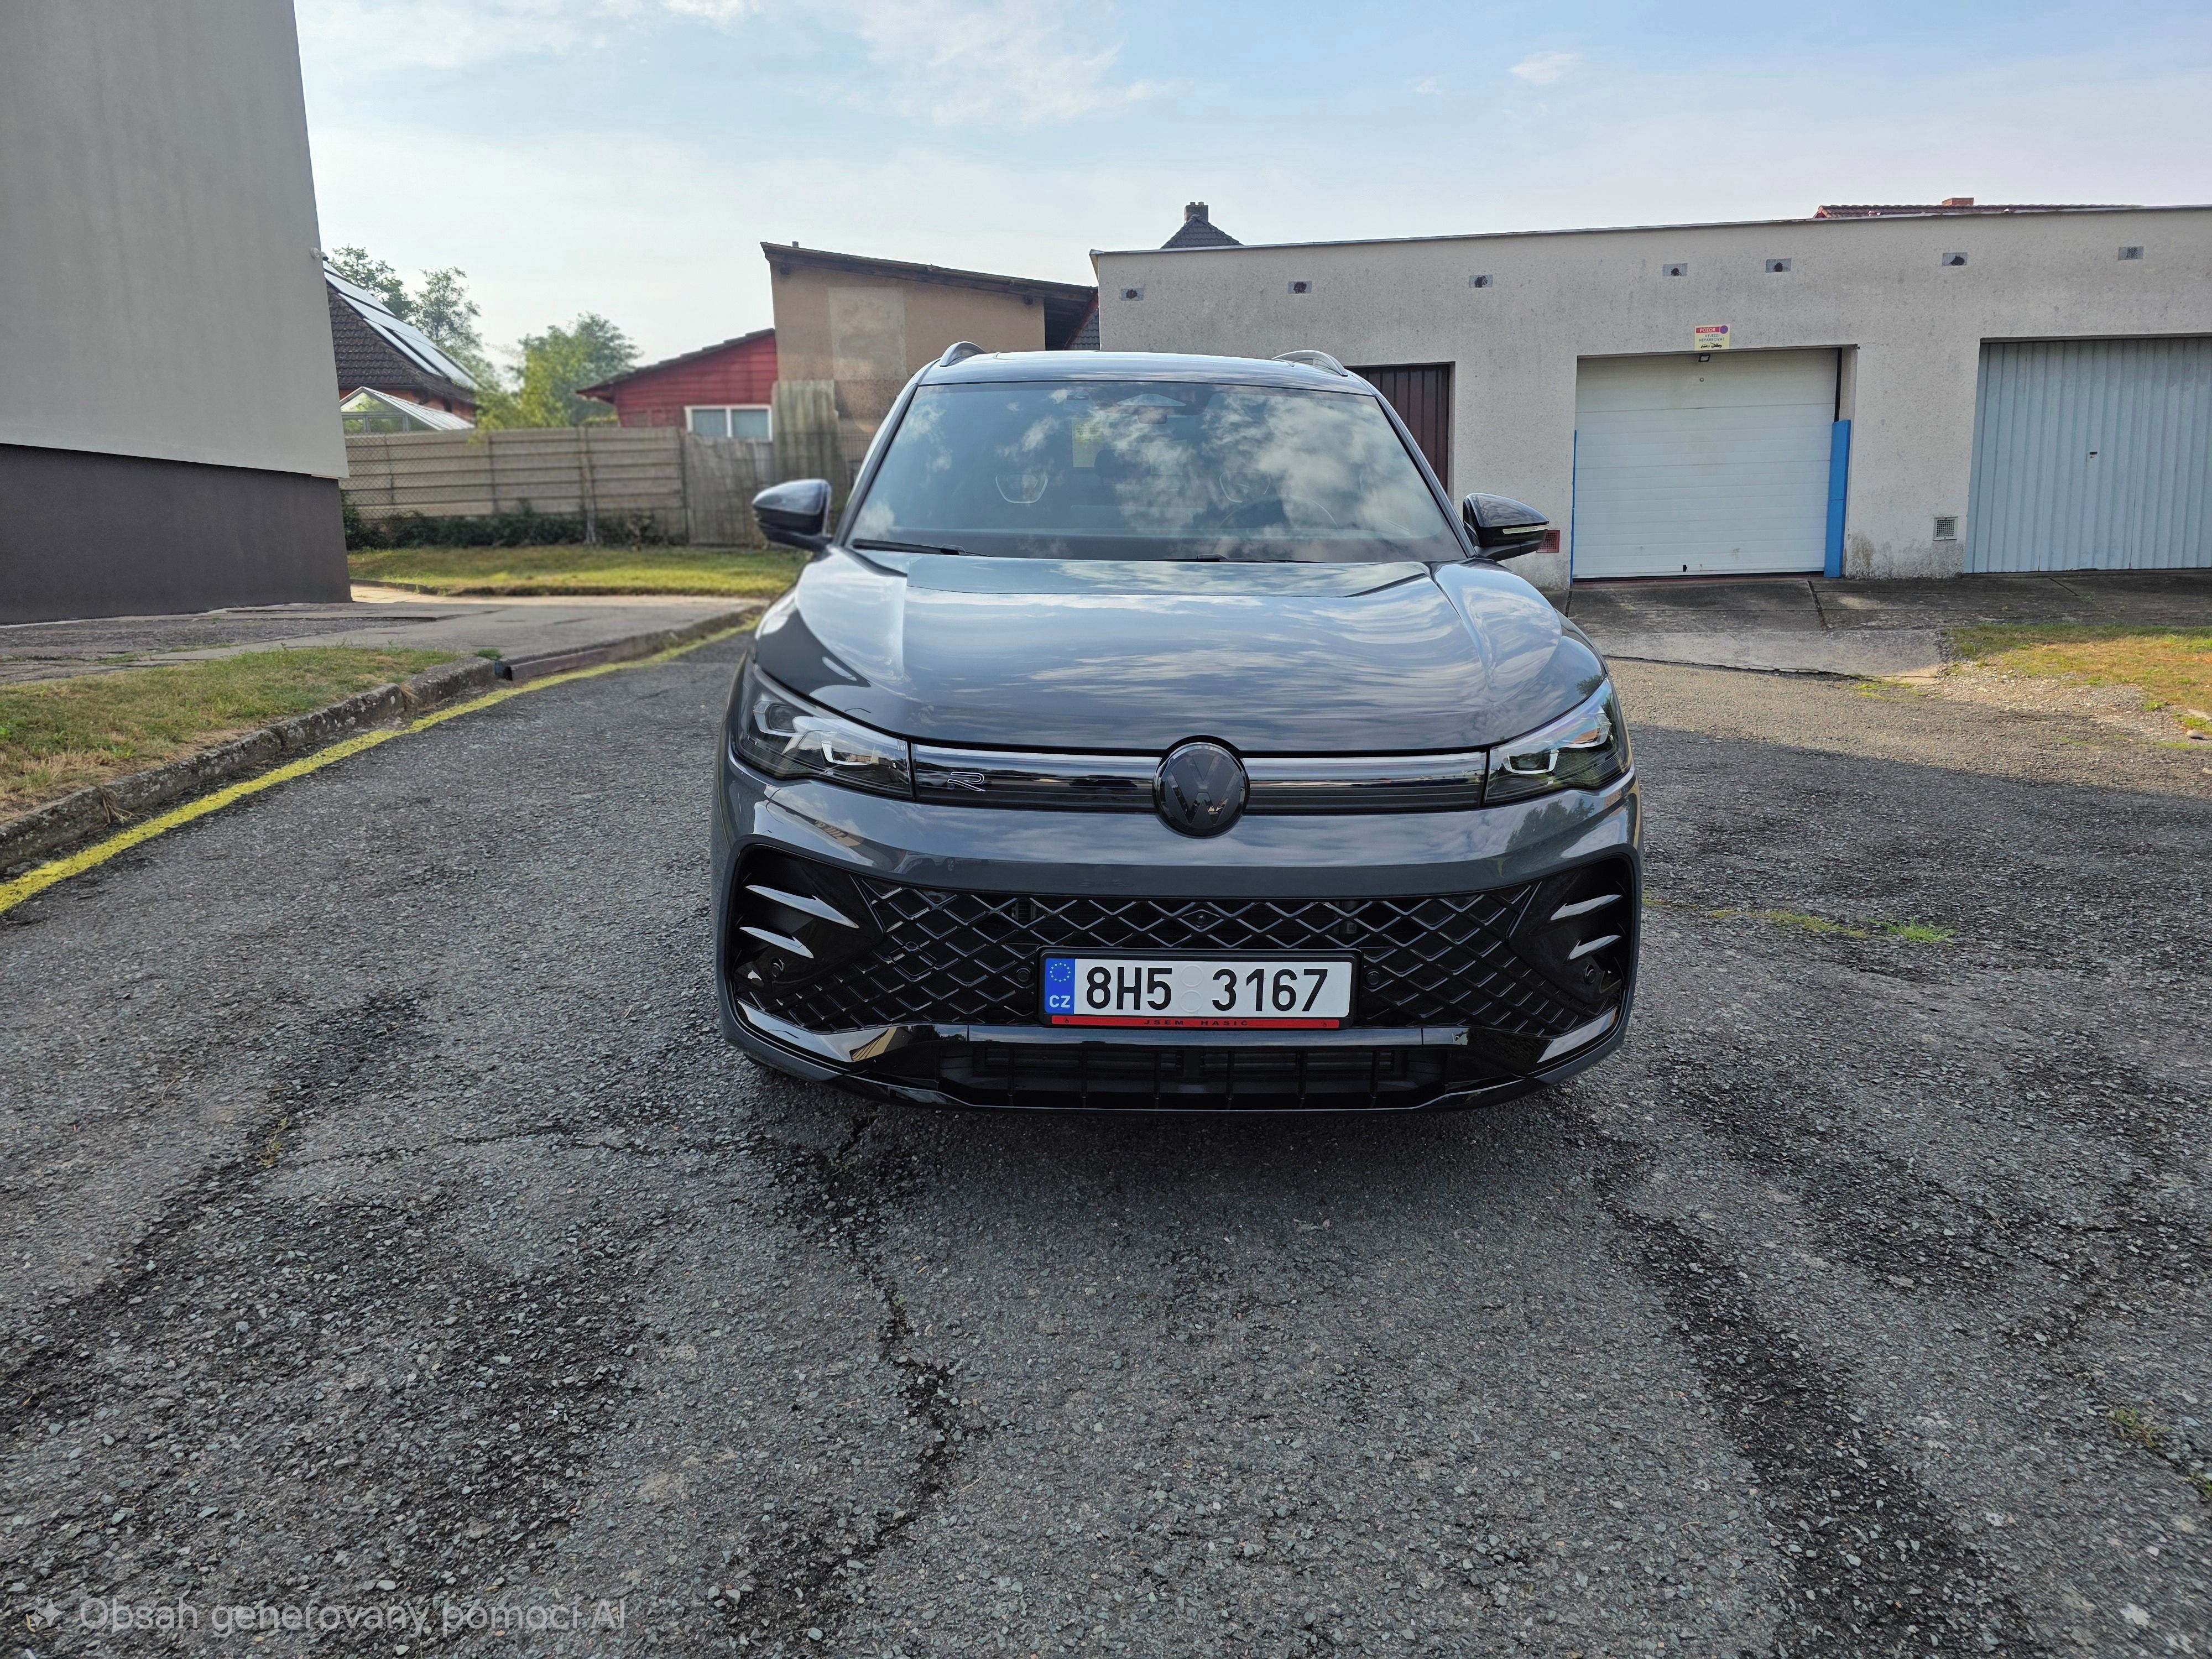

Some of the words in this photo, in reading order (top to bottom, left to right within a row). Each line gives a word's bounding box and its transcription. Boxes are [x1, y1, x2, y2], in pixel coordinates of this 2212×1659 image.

[1049, 995, 1071, 1008] CZ
[1086, 966, 1172, 1010] 8H5
[1212, 968, 1328, 1011] 3167
